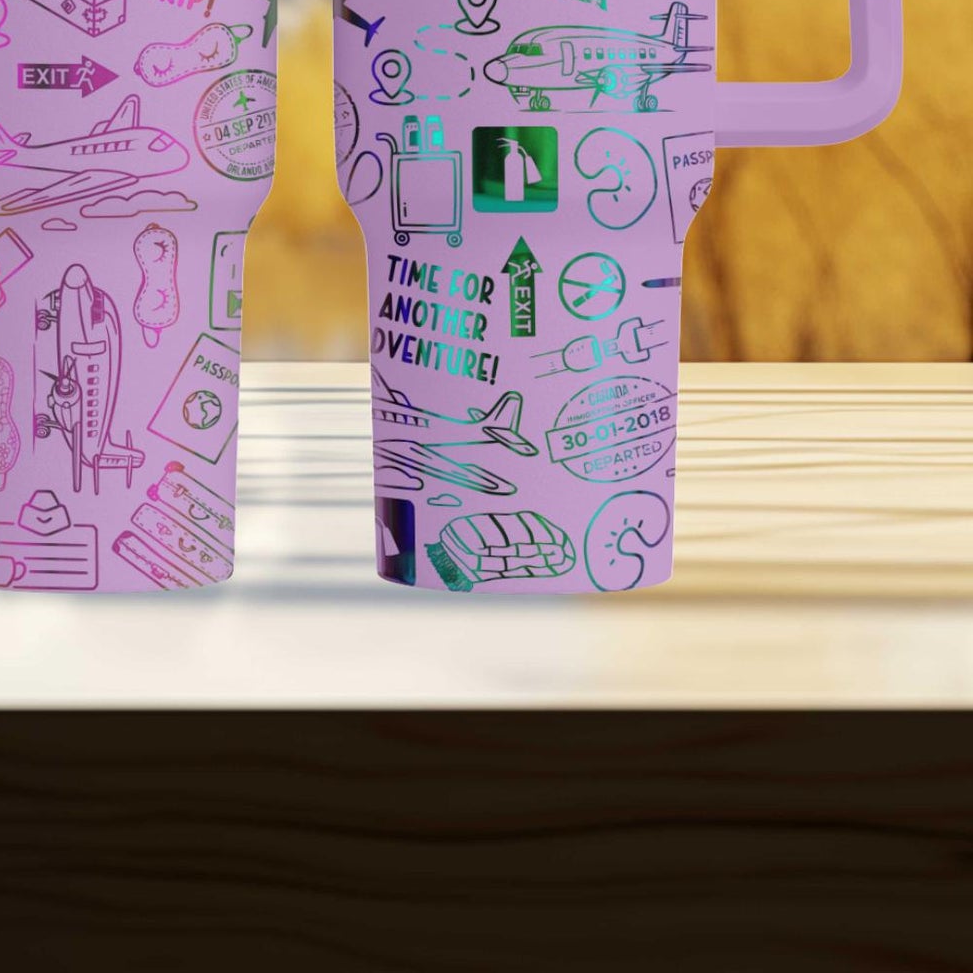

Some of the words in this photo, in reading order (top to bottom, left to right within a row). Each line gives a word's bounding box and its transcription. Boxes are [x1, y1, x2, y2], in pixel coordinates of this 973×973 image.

[22, 68, 69, 85] EXIT
[200, 93, 219, 120] UNITED
[218, 74, 243, 96] STATES
[245, 74, 255, 84] OF
[214, 125, 231, 141] 04
[232, 118, 254, 137] SEP
[229, 134, 276, 156] DEPARTE
[672, 150, 713, 170] PASSP
[387, 254, 442, 293] TIME
[449, 269, 494, 305] FOR
[379, 292, 487, 342] ANOTHER
[514, 286, 531, 333] EXIT
[588, 384, 629, 406] CANADA
[562, 406, 671, 451] 30-01-2018
[583, 441, 662, 474] DEPARTED
